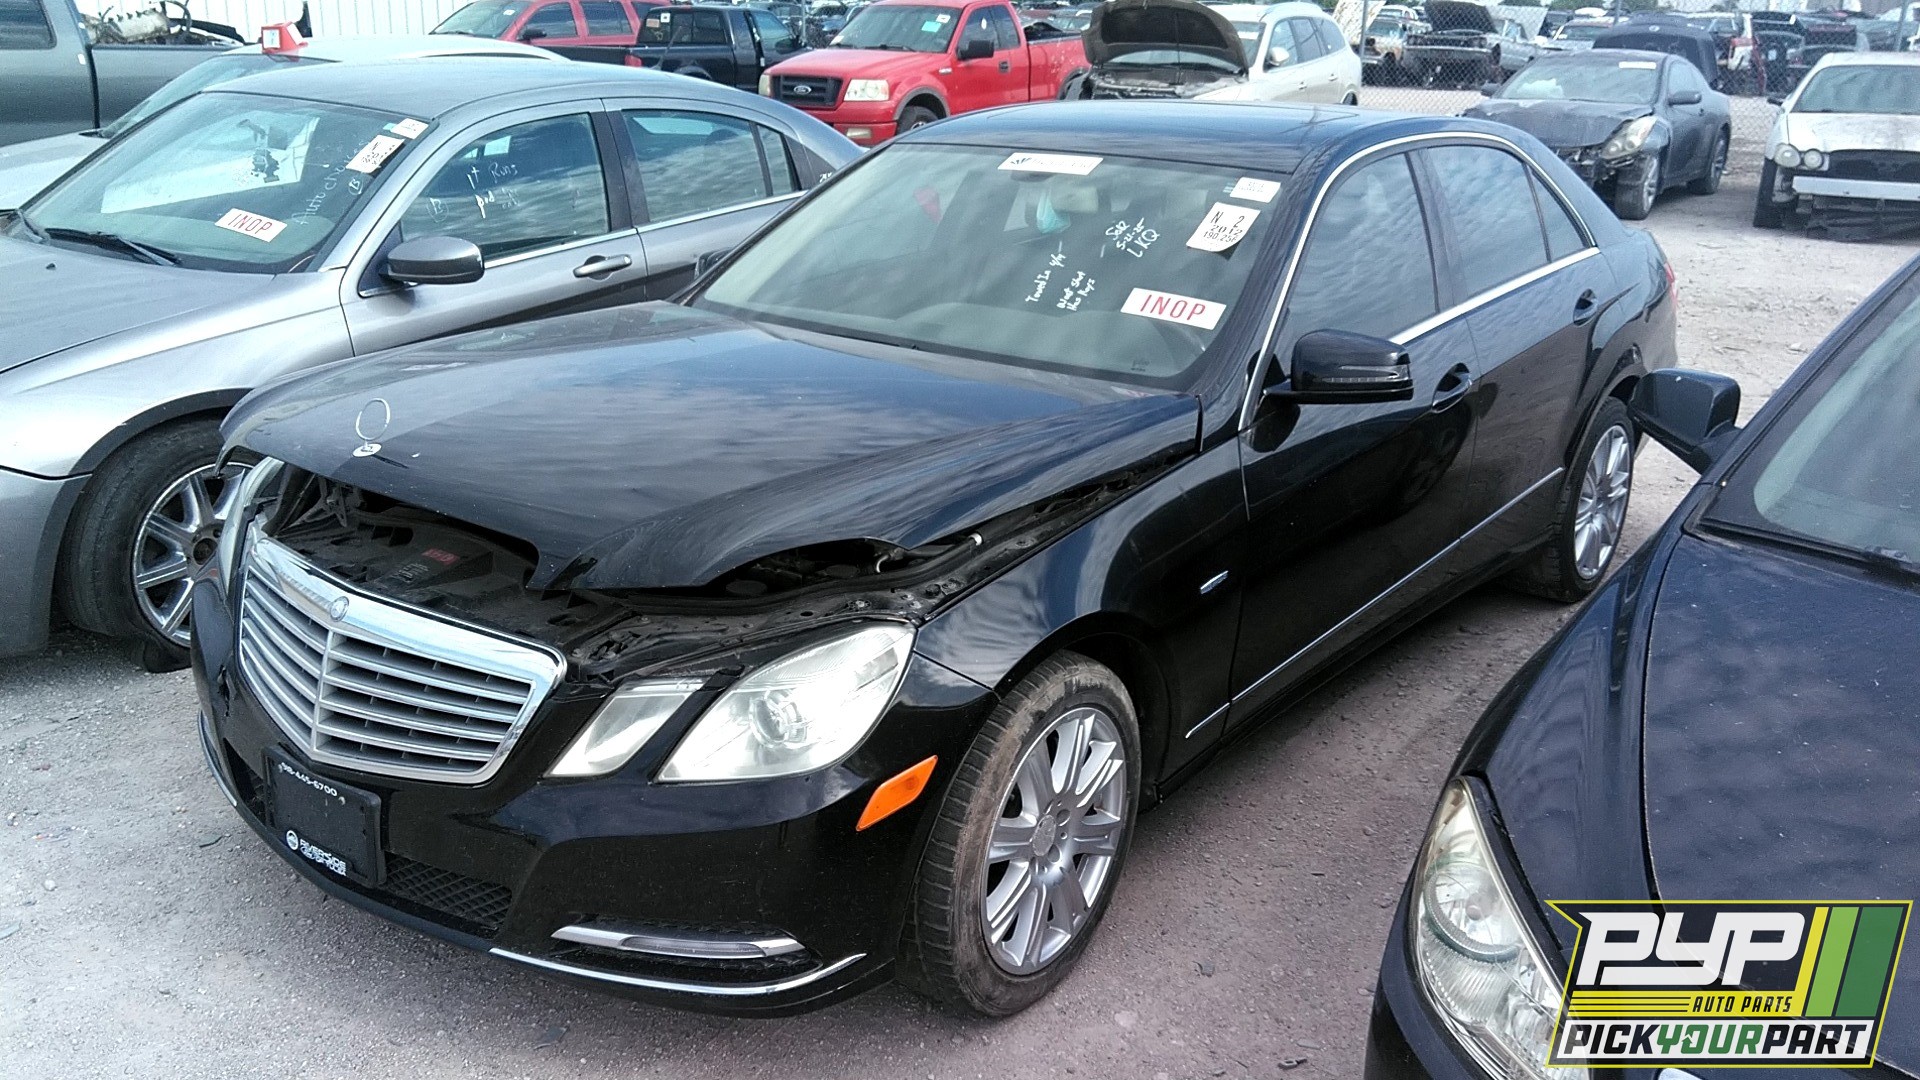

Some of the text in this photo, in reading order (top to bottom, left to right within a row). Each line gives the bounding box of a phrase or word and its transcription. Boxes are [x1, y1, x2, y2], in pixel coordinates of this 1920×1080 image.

[228, 213, 273, 235] INOP
[1210, 211, 1245, 228] N 2
[1210, 224, 1243, 237] 2012
[1126, 228, 1160, 258] LKQ
[1140, 294, 1206, 321] INOP
